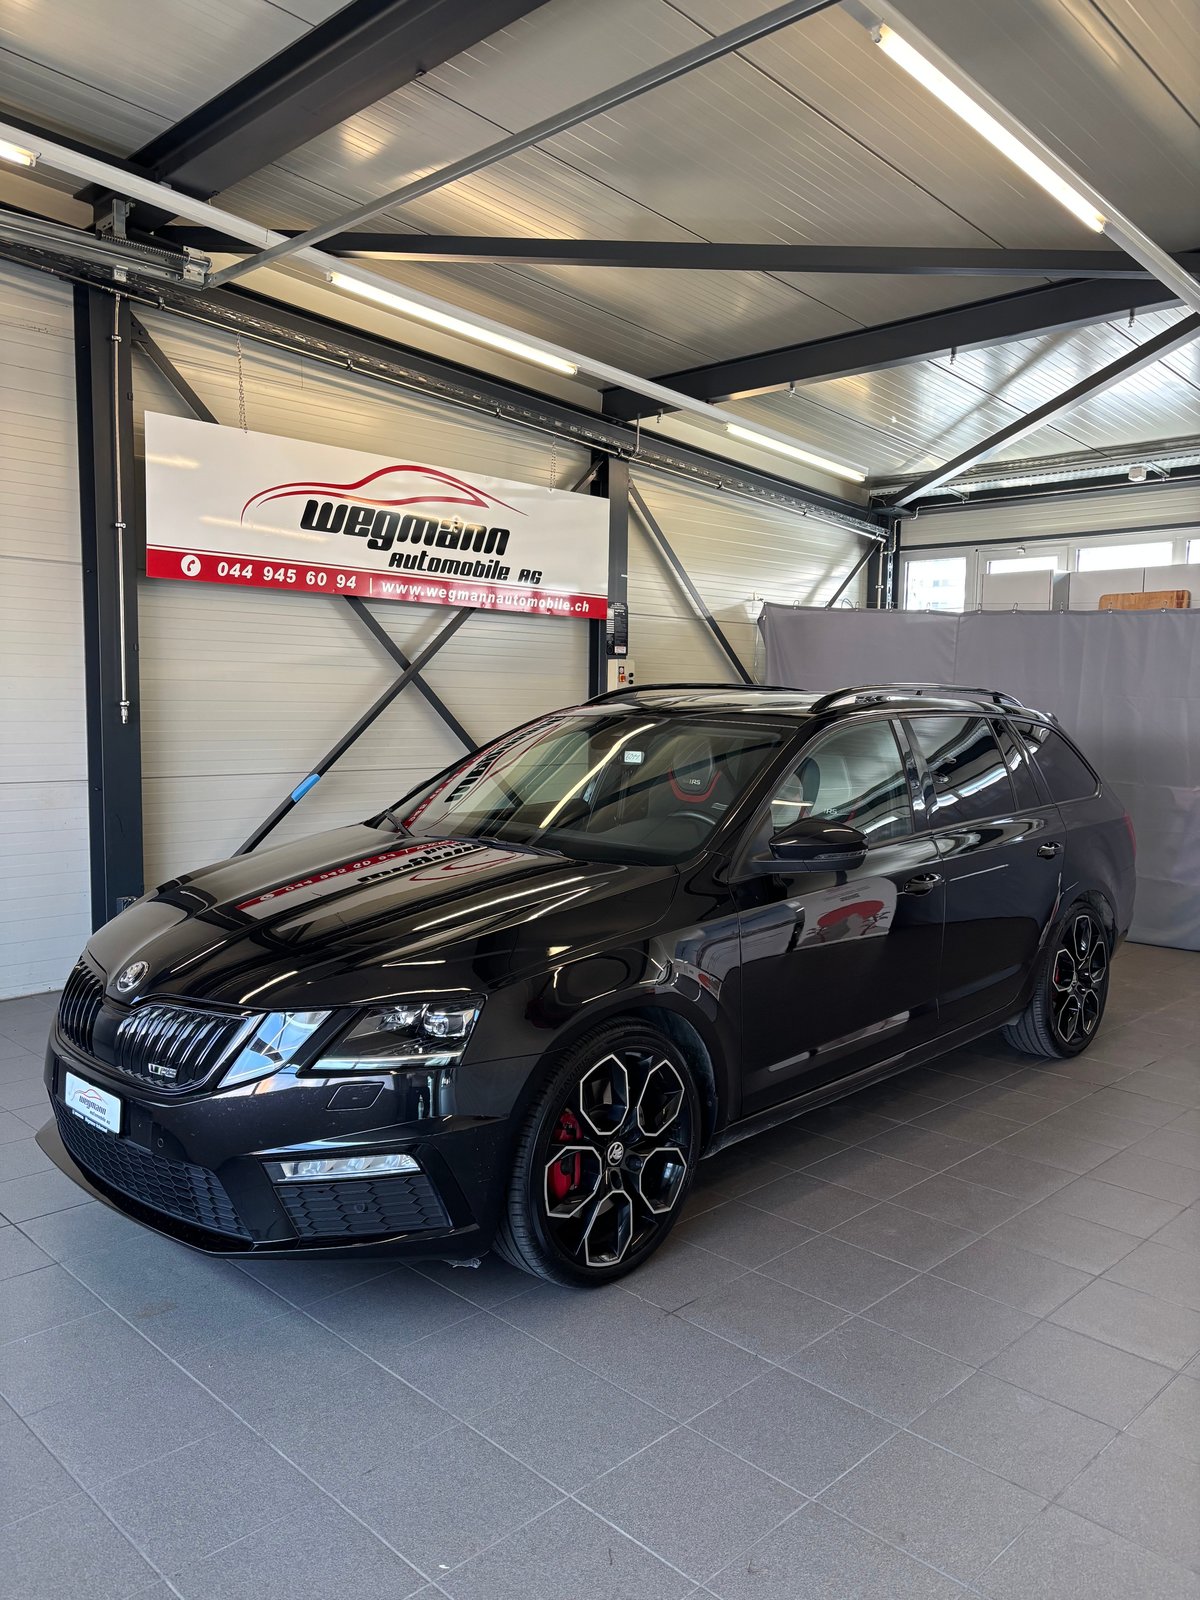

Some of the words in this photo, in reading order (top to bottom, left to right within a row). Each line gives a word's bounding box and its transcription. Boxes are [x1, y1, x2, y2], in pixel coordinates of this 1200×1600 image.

[300, 500, 511, 556] wegmann
[217, 562, 253, 579] 044
[263, 567, 297, 583] 945
[306, 571, 328, 586] 60
[336, 575, 357, 589] 94
[382, 582, 590, 612] www.wegmannautomobile.ch
[518, 569, 543, 584] AG
